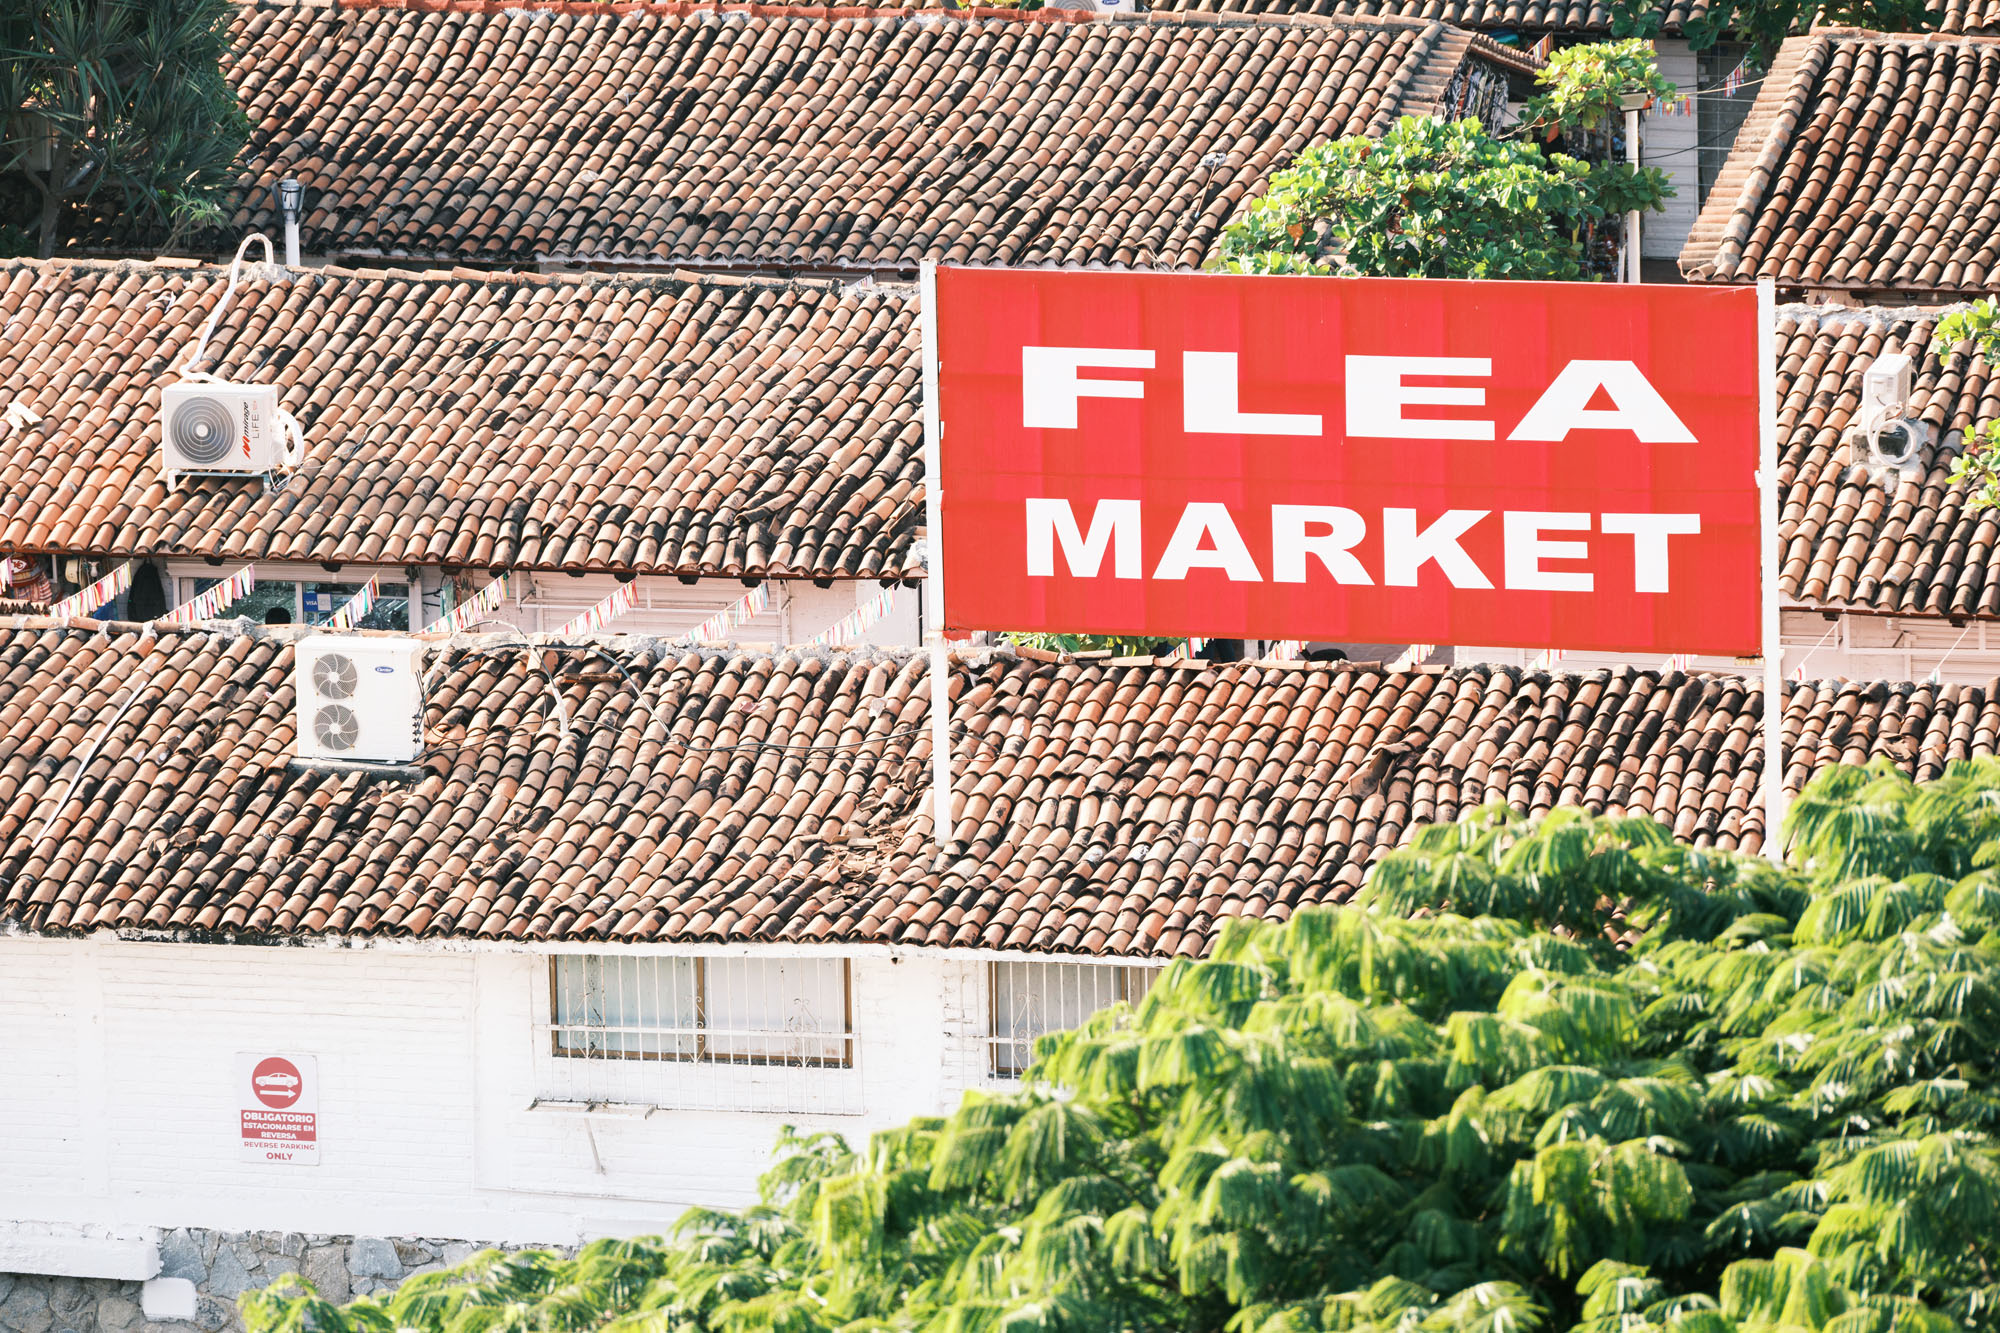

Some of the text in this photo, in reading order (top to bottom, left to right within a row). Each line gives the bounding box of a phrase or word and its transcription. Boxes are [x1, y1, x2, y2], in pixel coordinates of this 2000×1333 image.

[1022, 346, 1698, 444] FLEA
[1026, 497, 1701, 594] MARKET
[243, 1112, 313, 1123] OBLIGATORIO
[243, 1122, 302, 1131] ESTACIONARSE
[261, 1131, 296, 1139] REVERSA
[244, 1141, 278, 1149] REVERSE
[266, 1152, 293, 1160] ONLY
